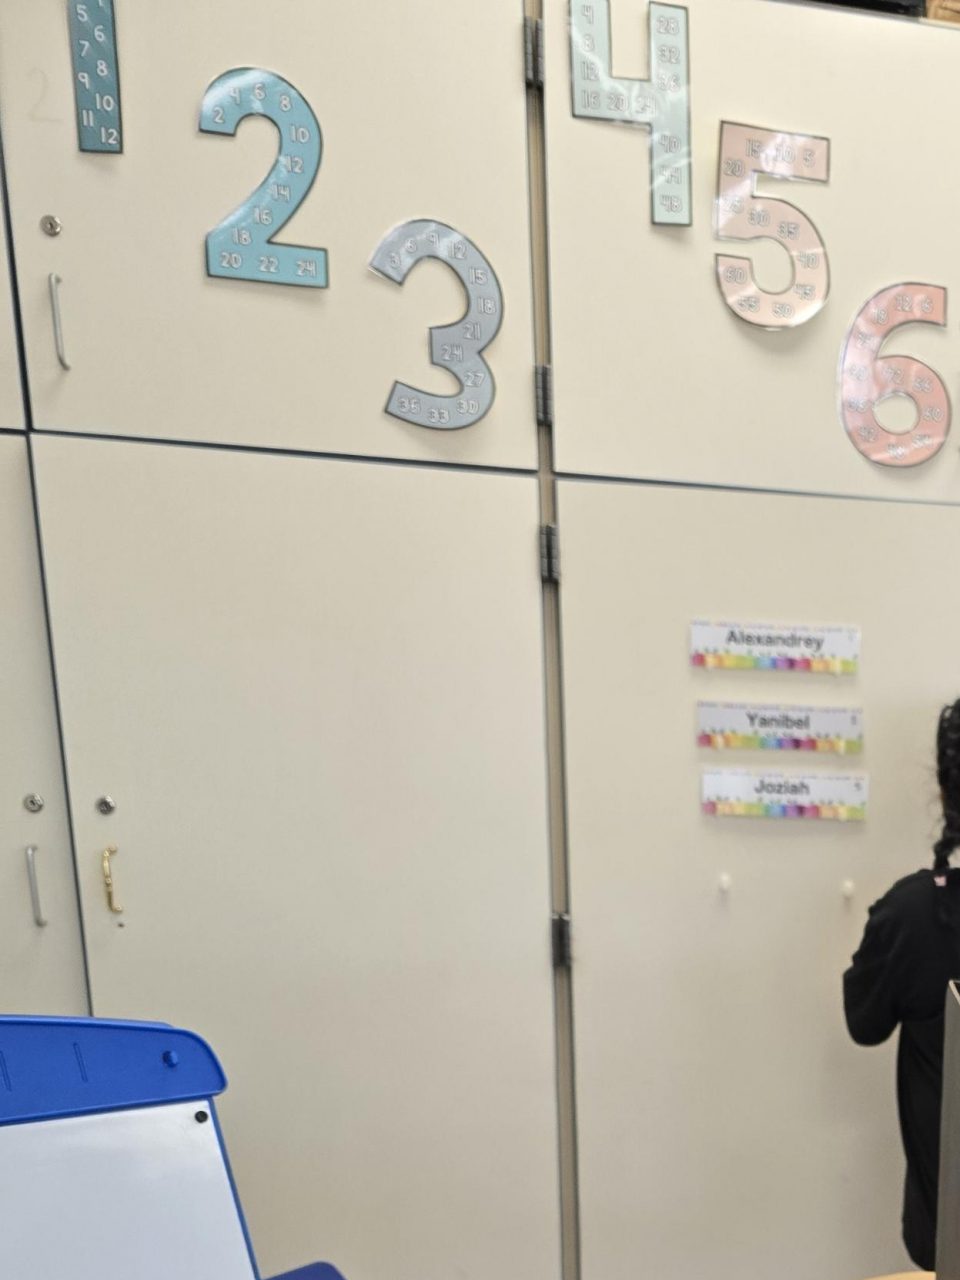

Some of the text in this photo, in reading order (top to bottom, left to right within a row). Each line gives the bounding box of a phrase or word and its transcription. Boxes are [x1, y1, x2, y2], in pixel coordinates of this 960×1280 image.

[76, 4, 88, 21] 5
[581, 5, 594, 25] 4
[94, 25, 105, 41] 6
[79, 40, 90, 56] 7
[96, 60, 108, 76] 8
[78, 72, 89, 89] 9
[229, 87, 240, 105] 4
[254, 83, 266, 100] 6
[95, 93, 114, 111] 10
[280, 95, 291, 111] 8
[82, 109, 94, 127] 11
[214, 107, 224, 123] 2
[569, 0, 692, 226] 4
[101, 126, 118, 144] 12
[290, 125, 310, 143] 10
[284, 156, 304, 174] 12
[198, 66, 330, 289] 2
[271, 183, 290, 201] 14
[254, 207, 273, 225] 16
[714, 120, 830, 328] 5
[233, 227, 251, 245] 18
[429, 233, 440, 248] 9
[405, 239, 417, 253] 6
[450, 240, 467, 260] 12
[221, 252, 317, 278] 20 22 24
[390, 252, 401, 268] 3
[469, 268, 488, 285] 15
[478, 298, 497, 315] 18
[368, 217, 504, 431] 3
[463, 324, 480, 340] 21
[442, 345, 464, 362] 24
[465, 372, 485, 388] 27
[838, 281, 952, 468] 6
[428, 408, 450, 425] 33
[457, 399, 479, 414] 30
[727, 630, 825, 652] Alexandrey
[746, 712, 811, 730] Yanibel
[754, 779, 811, 796] Joziah
